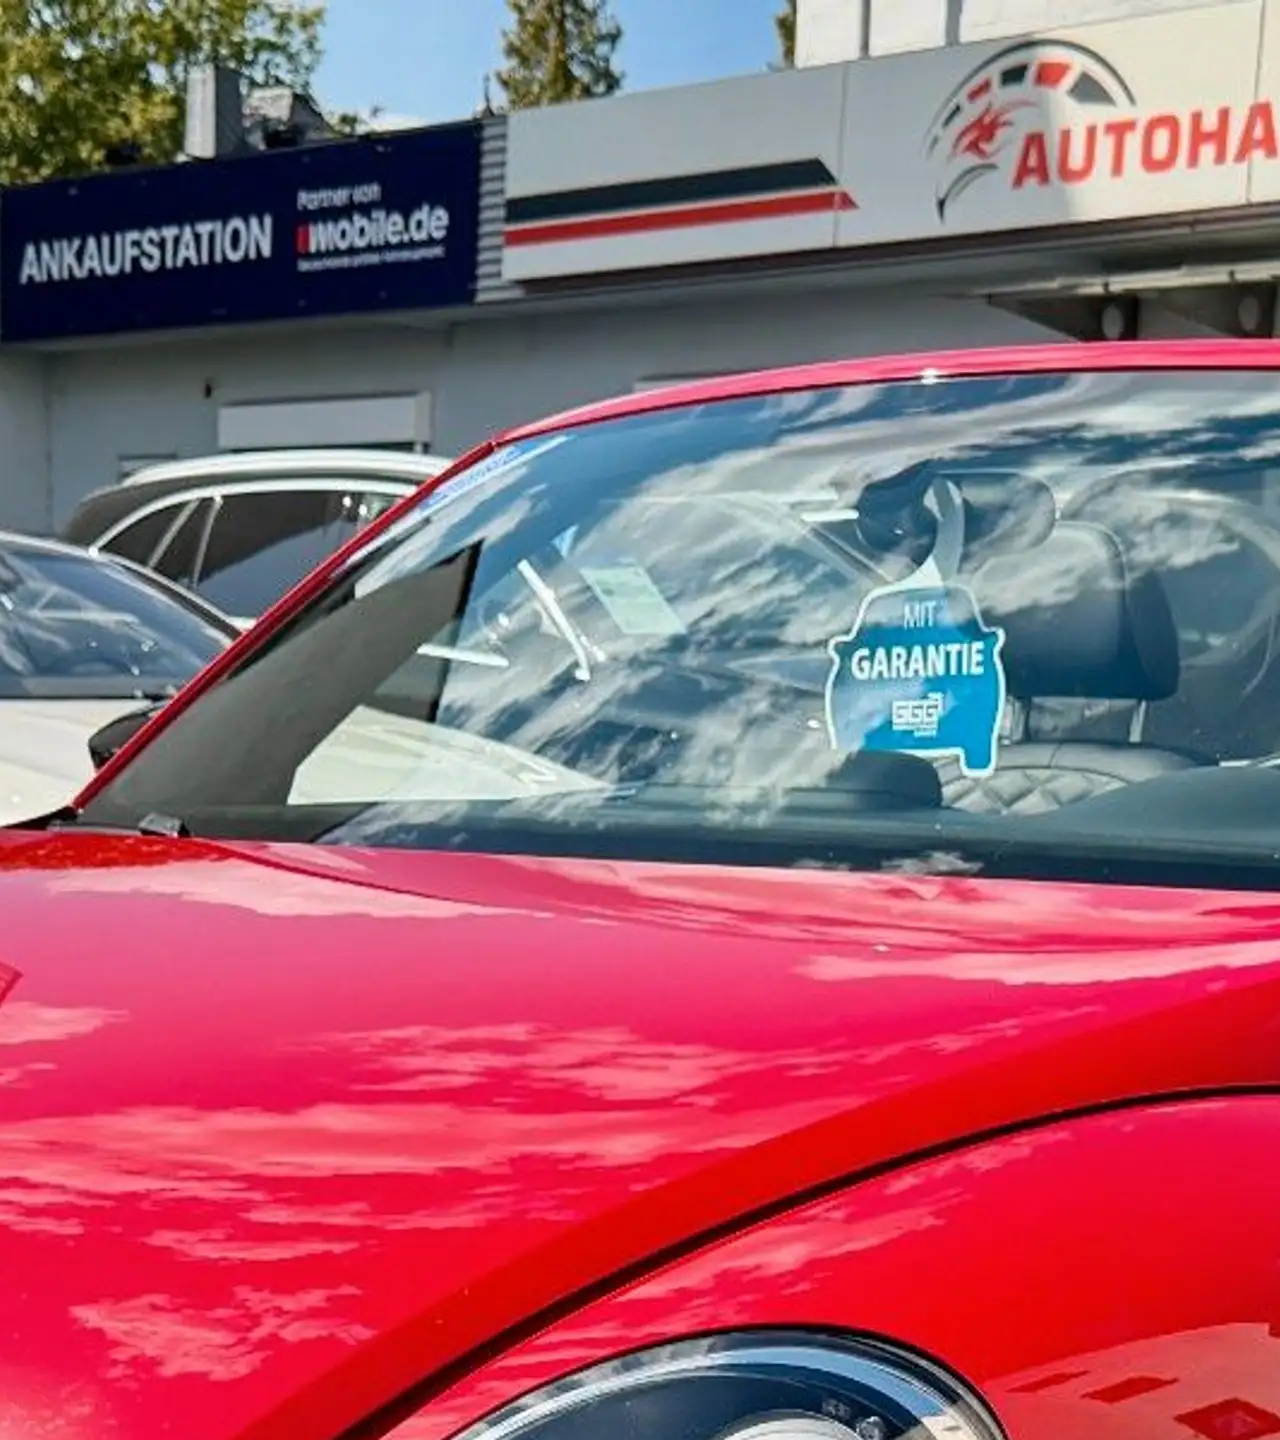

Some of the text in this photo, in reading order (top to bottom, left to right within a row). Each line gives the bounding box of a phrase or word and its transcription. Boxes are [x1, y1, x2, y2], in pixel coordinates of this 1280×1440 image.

[20, 214, 272, 284] ANKAUFSTATION
[308, 204, 449, 253] mobile.de
[904, 601, 937, 629] MIT
[851, 641, 985, 681] GARANTIE
